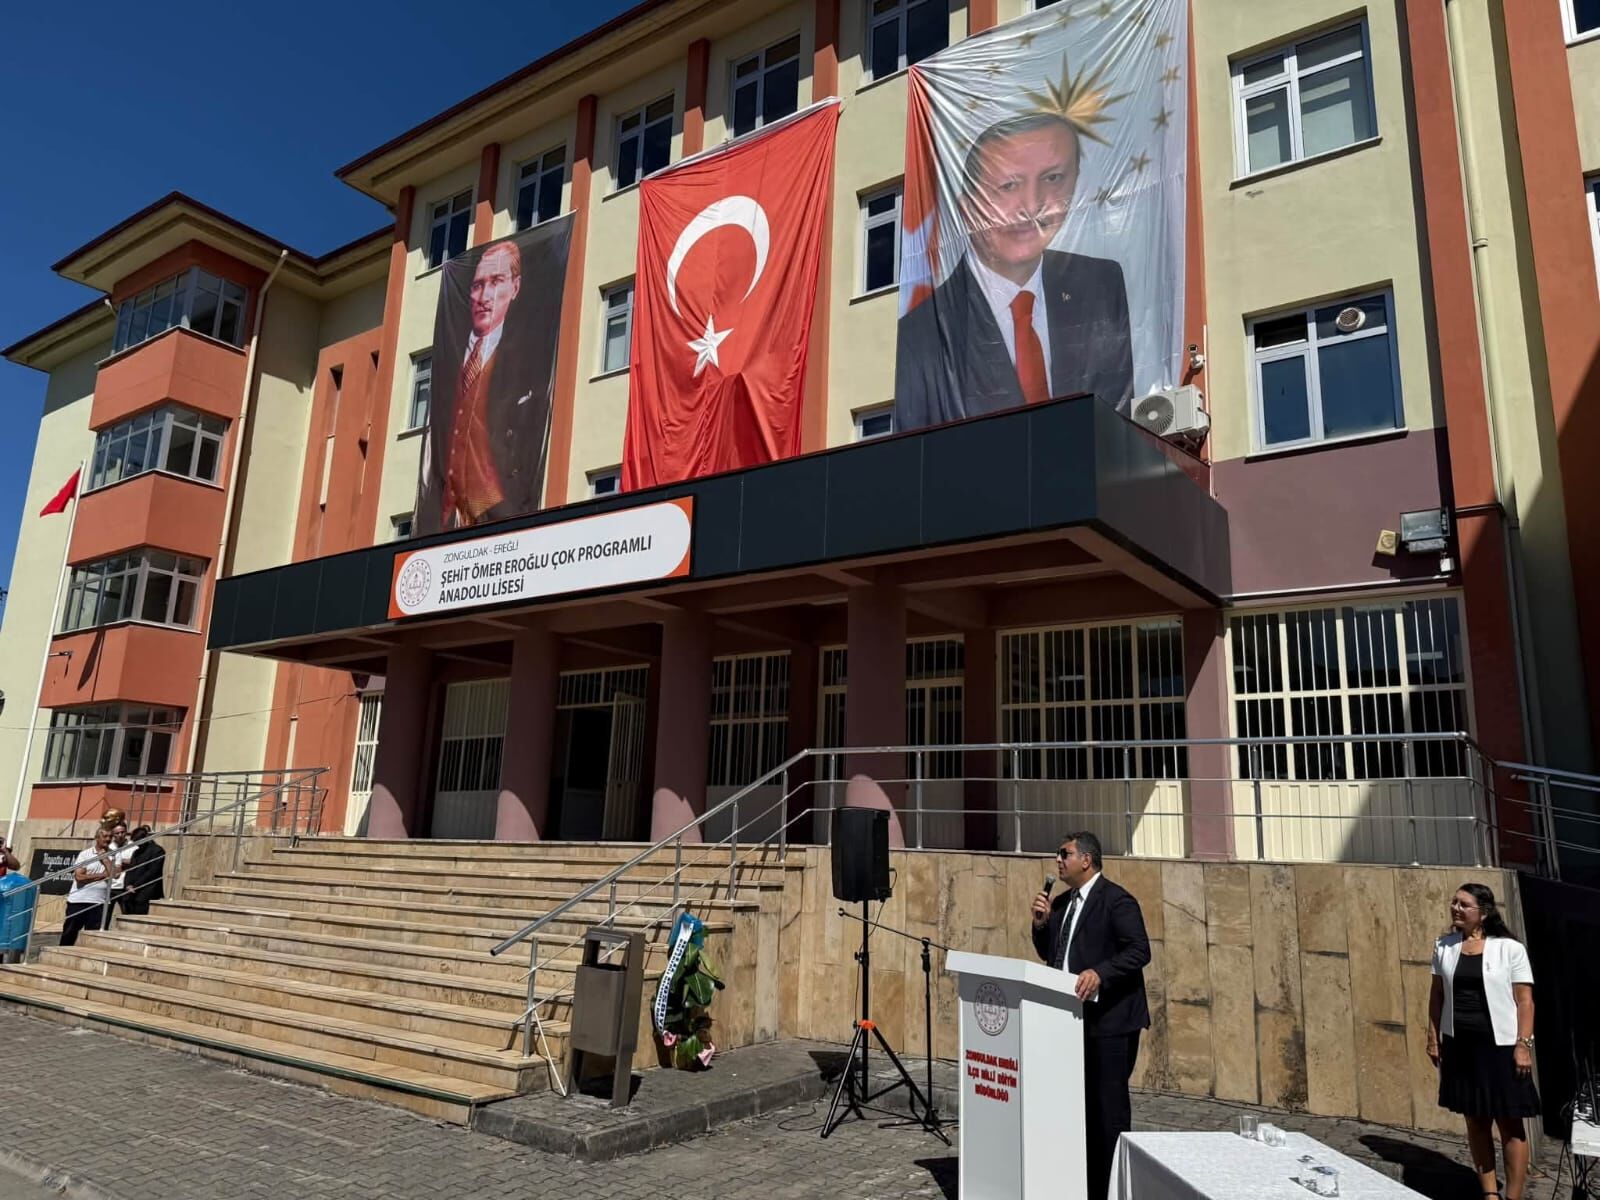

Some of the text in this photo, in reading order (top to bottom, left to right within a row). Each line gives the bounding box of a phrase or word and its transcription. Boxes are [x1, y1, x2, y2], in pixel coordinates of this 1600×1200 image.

[440, 565, 470, 588] ŞEHİT
[471, 562, 502, 579] ÖMER
[504, 553, 549, 574] EROĞLU
[551, 548, 576, 570] ÇOK
[578, 534, 652, 562] PROGRAMLI
[443, 546, 488, 563] ZONGULDAK
[438, 583, 490, 604] ANADOLU
[492, 574, 525, 596] LİSESİ
